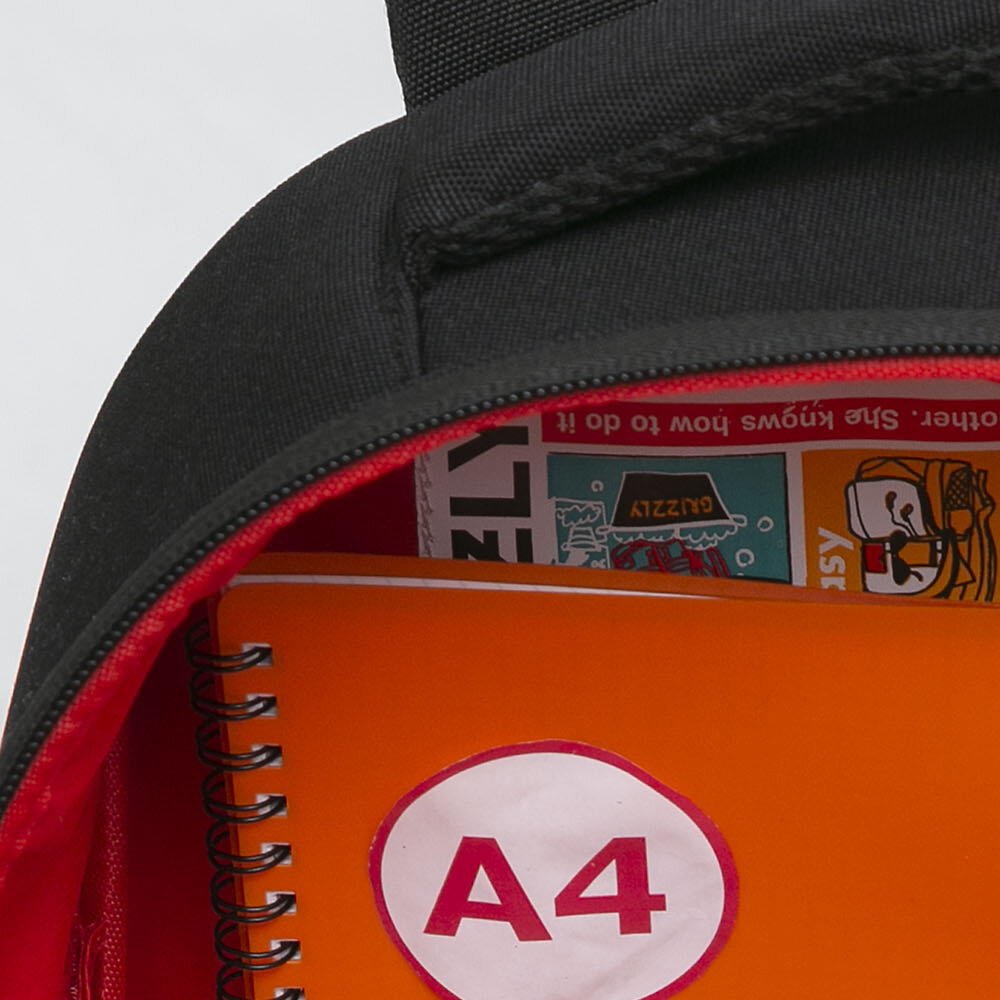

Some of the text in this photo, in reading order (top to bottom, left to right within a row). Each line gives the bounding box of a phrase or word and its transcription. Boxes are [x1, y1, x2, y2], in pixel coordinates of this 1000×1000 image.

[557, 411, 576, 434] it
[586, 412, 621, 435] do
[630, 412, 660, 436] to
[671, 413, 729, 437] how
[740, 405, 834, 429] knows
[845, 407, 899, 431] She
[630, 496, 714, 518] GRIZZLY
[818, 527, 855, 591] asy
[423, 836, 667, 942] A4
